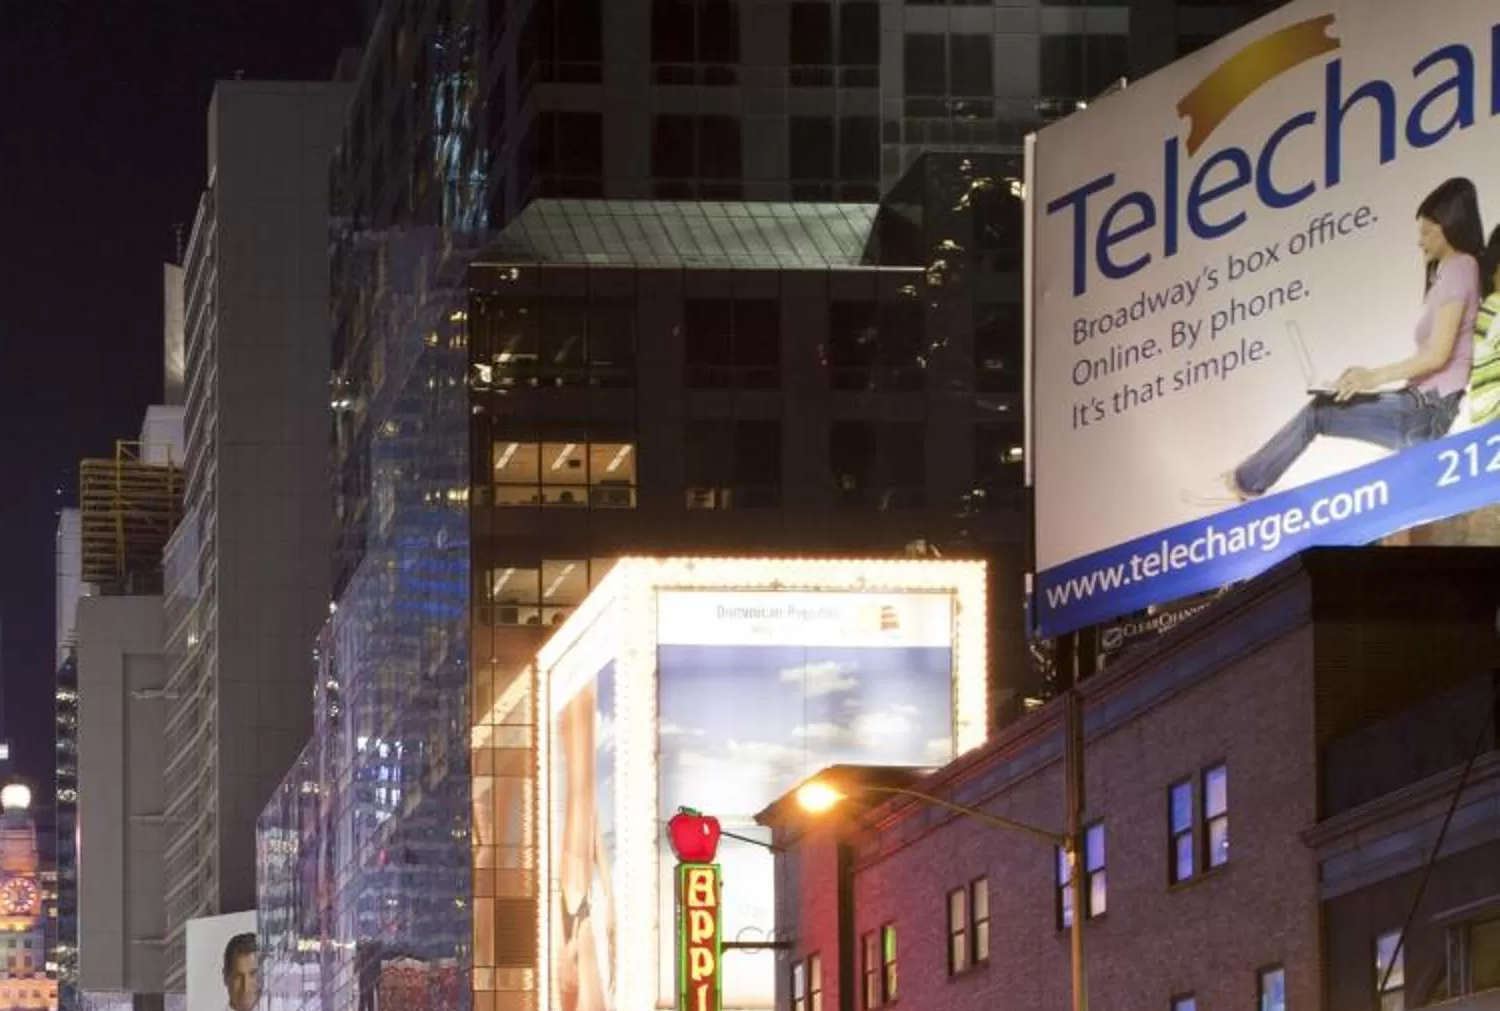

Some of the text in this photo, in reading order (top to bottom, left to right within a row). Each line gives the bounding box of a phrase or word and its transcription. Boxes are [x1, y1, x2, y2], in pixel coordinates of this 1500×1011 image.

[1072, 279, 1310, 386] Online. By phone.
[1073, 205, 1378, 344] Broadway's box office.
[1073, 337, 1271, 429] It's that simple.
[1047, 475, 1389, 609] www.telecharge.com
